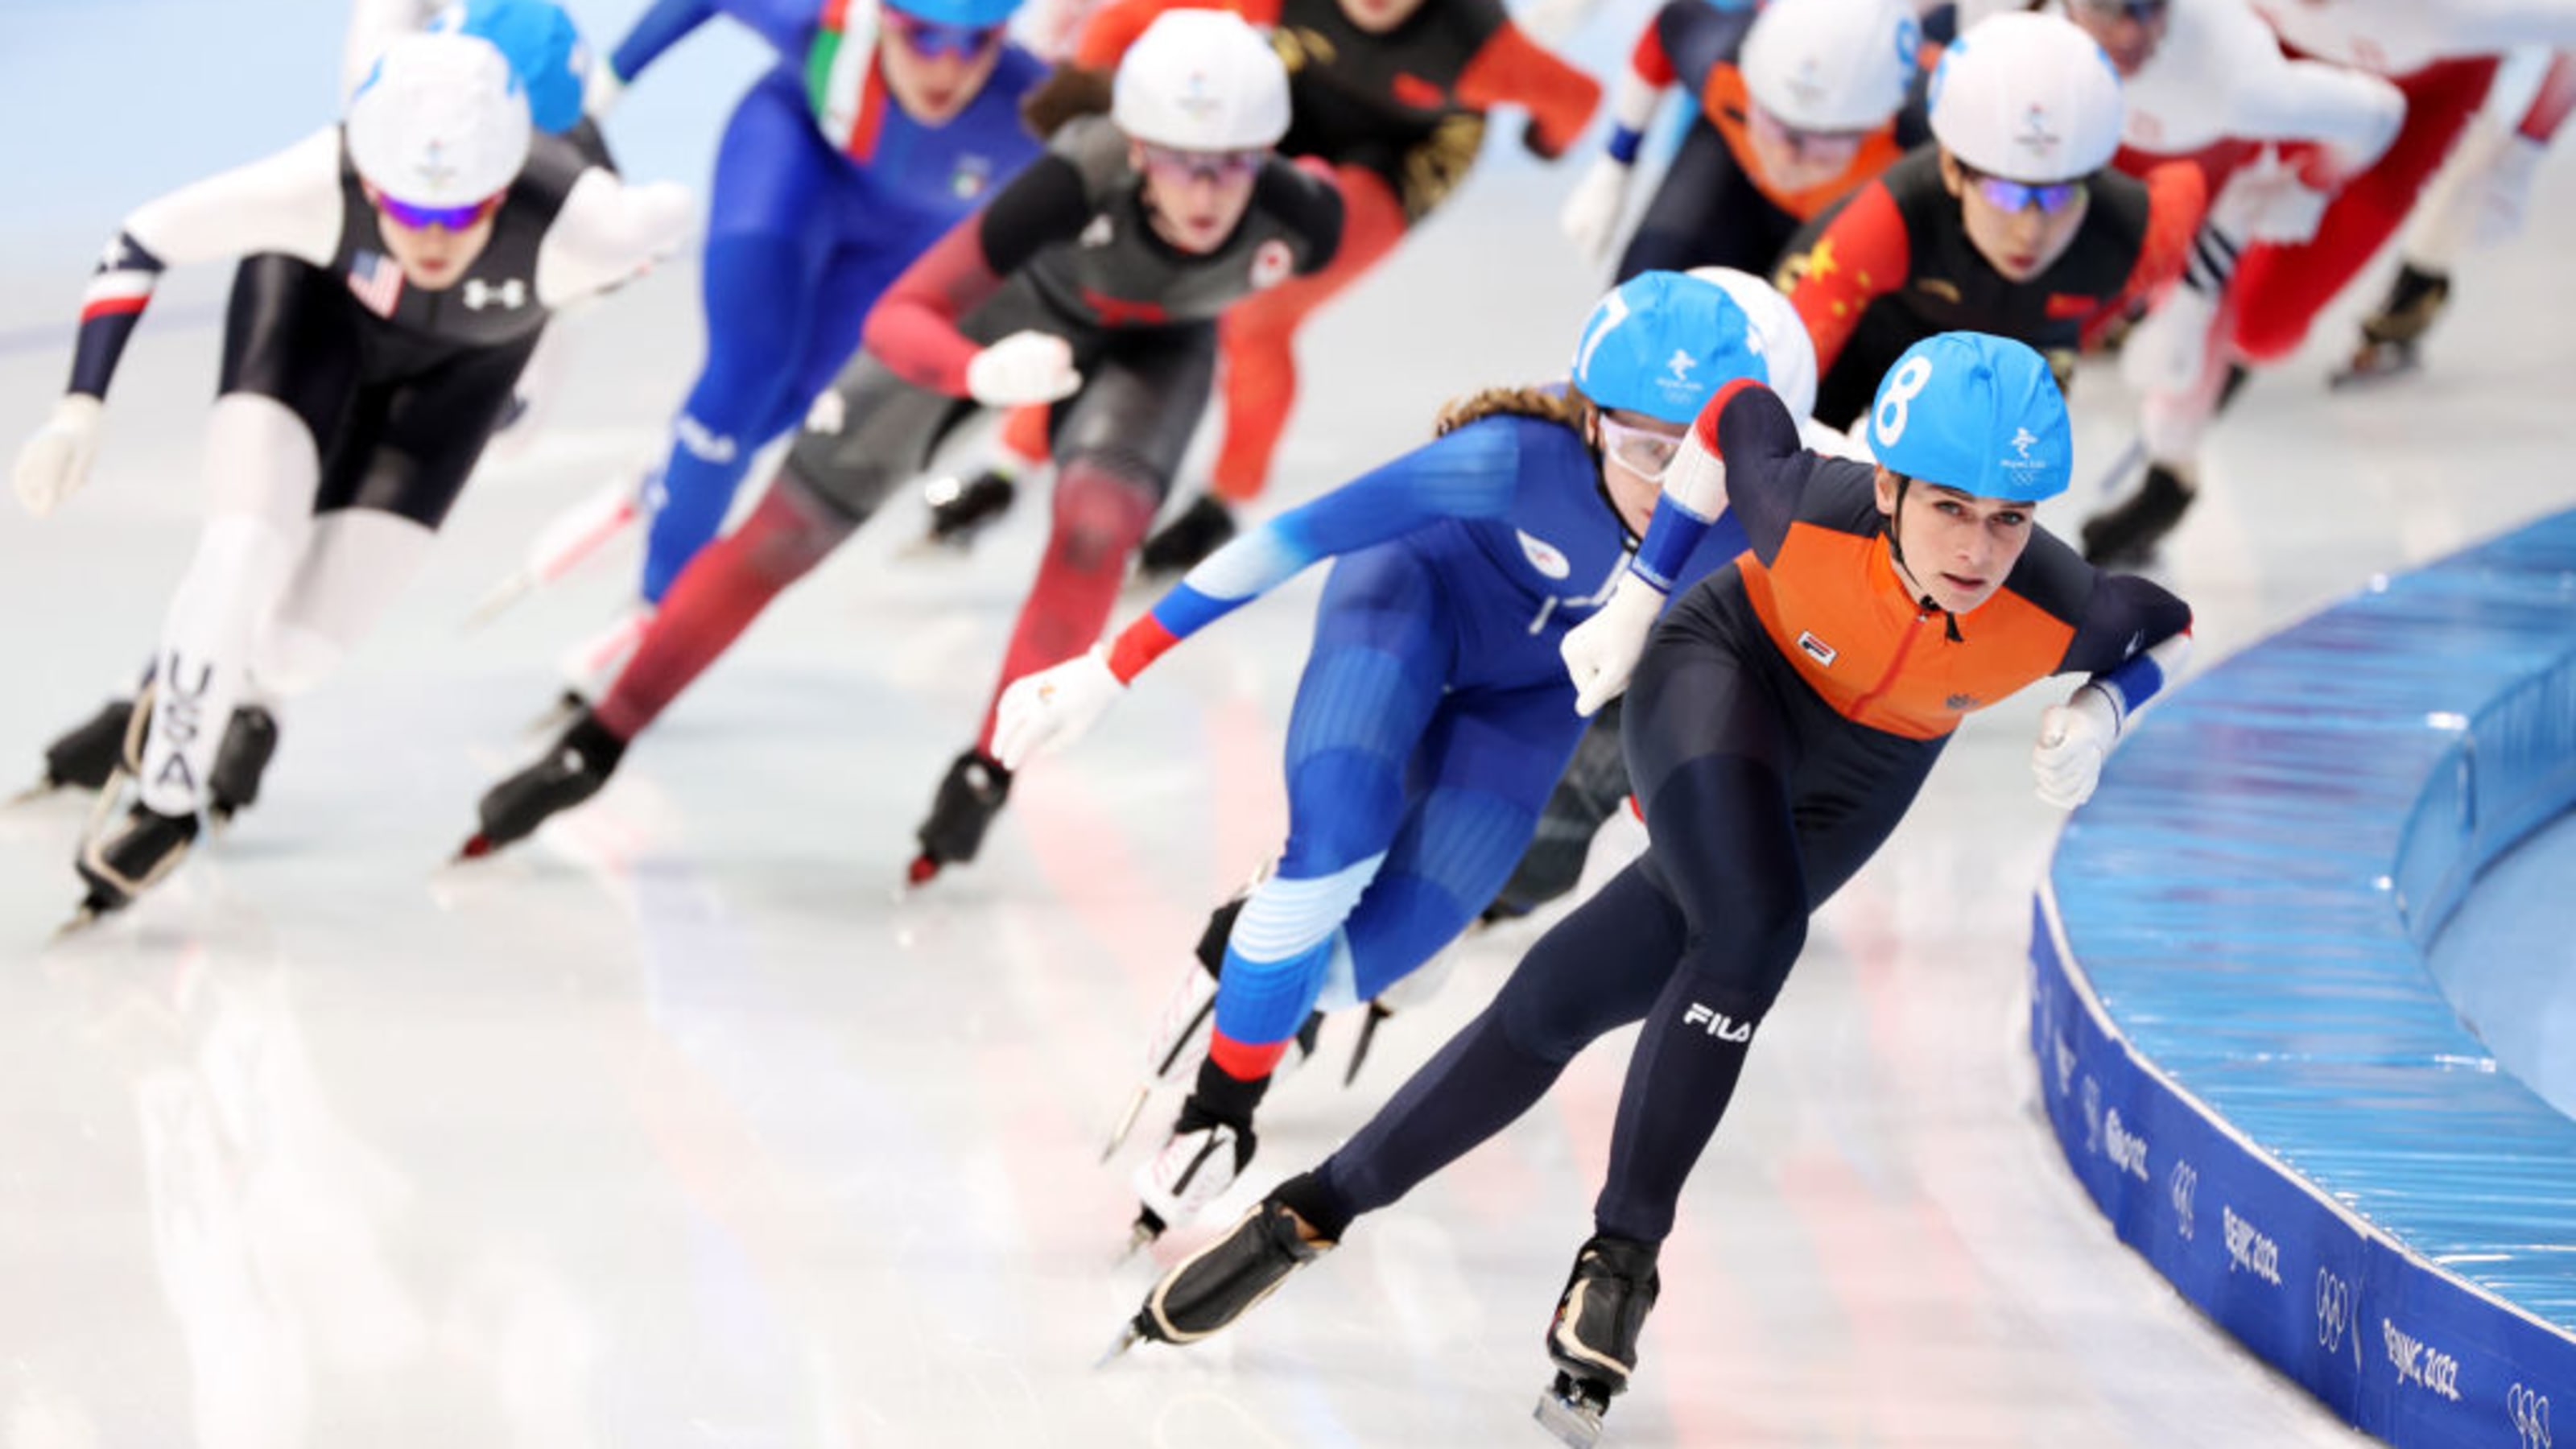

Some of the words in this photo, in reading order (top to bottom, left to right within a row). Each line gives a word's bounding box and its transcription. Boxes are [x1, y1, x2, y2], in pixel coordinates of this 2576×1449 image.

[1876, 355, 1932, 448] 8
[157, 650, 213, 790] USA
[1683, 1001, 1752, 1043] FILA
[2425, 1347, 2462, 1402] 2022
